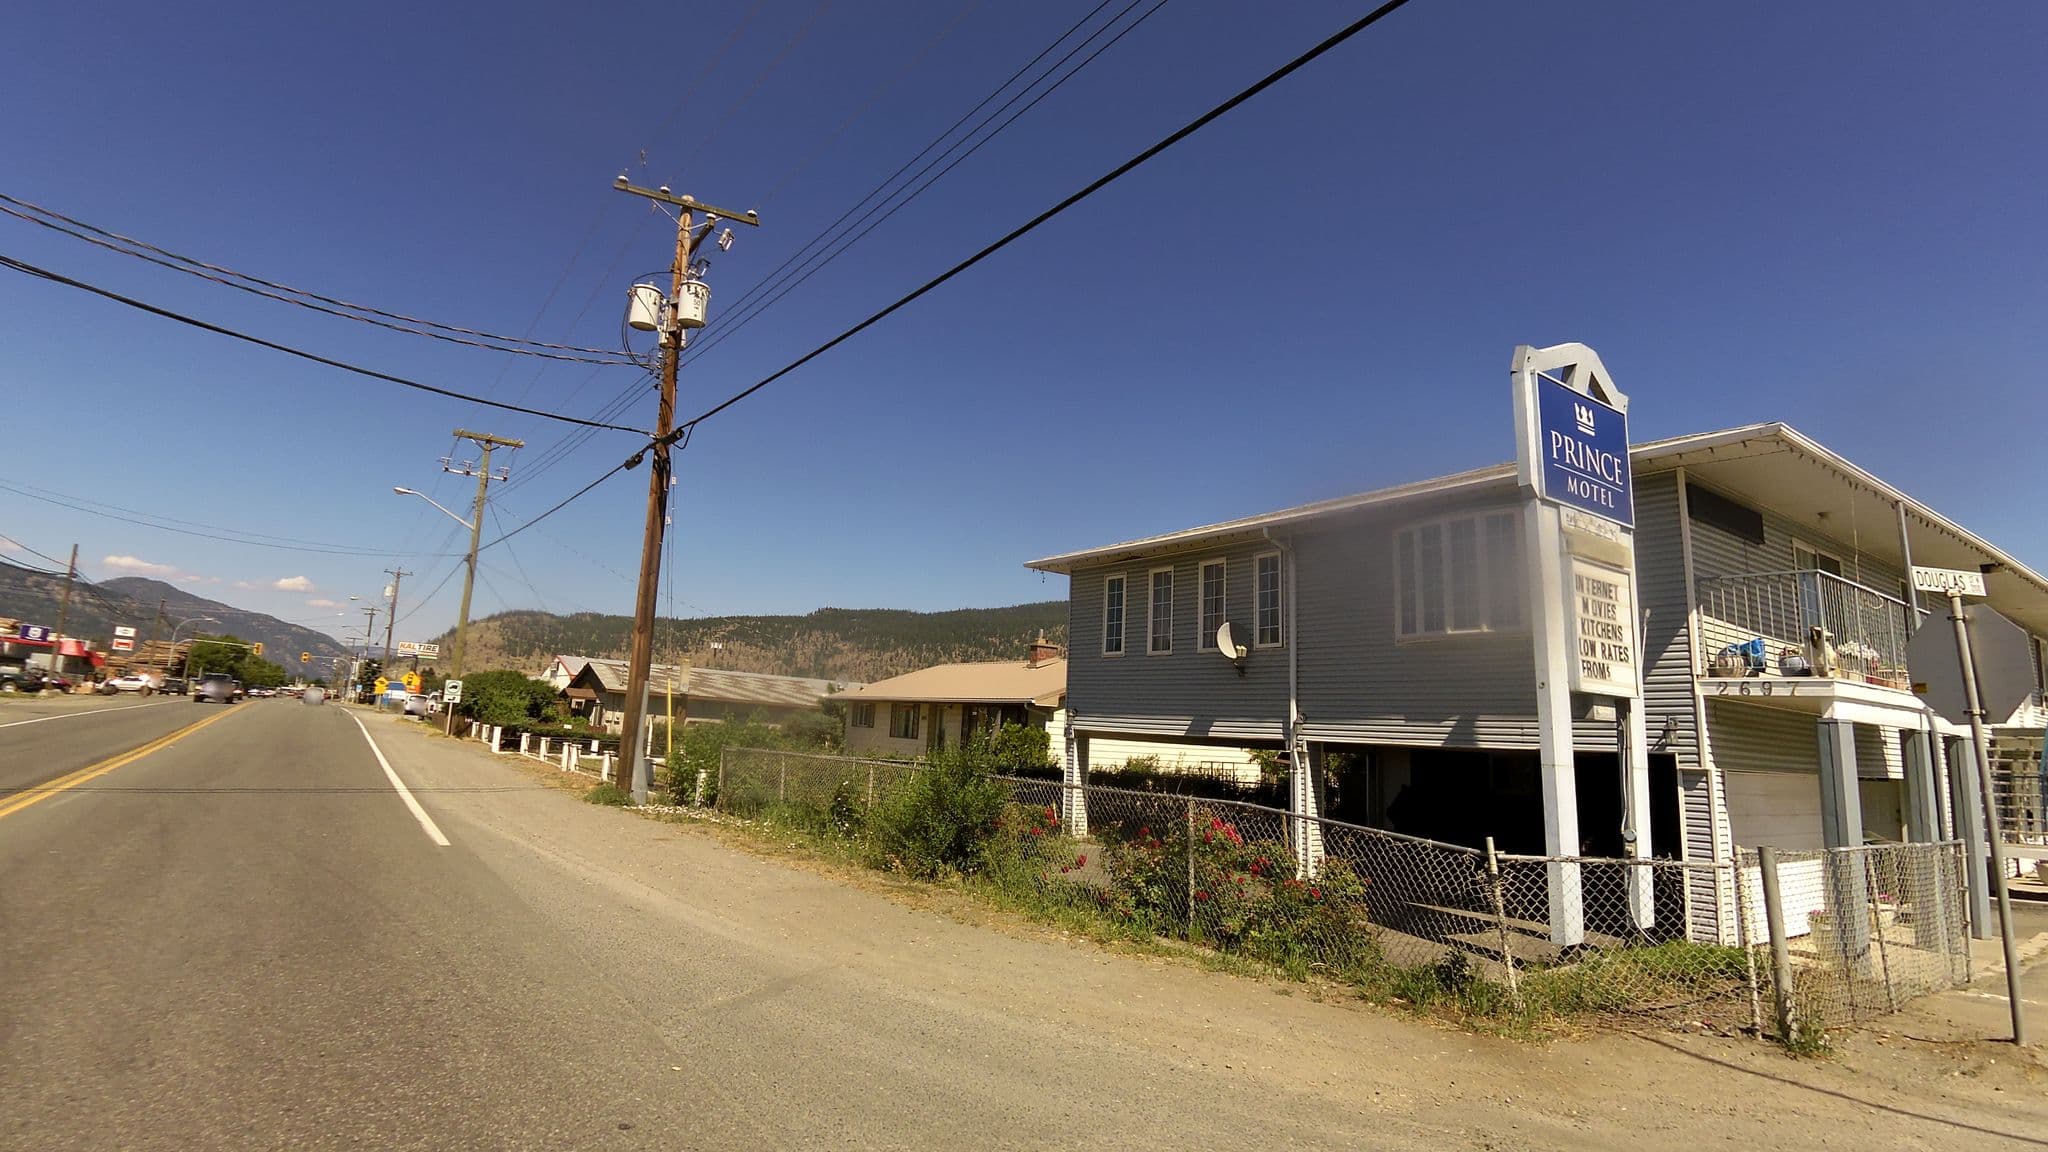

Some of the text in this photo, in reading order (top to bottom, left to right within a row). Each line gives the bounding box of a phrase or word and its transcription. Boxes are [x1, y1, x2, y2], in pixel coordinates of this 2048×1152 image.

[1551, 429, 1623, 485] PRINCE
[1567, 475, 1615, 508] MOTEL
[1575, 574, 1619, 602] INTERNET
[1916, 570, 1966, 590] DOUGLAS
[1582, 597, 1617, 621] MOVIES
[1580, 618, 1624, 642] KITCHENS
[418, 644, 438, 652] TIRE
[1578, 638, 1630, 663] LOW RATES
[1716, 680, 1800, 697] 2697
